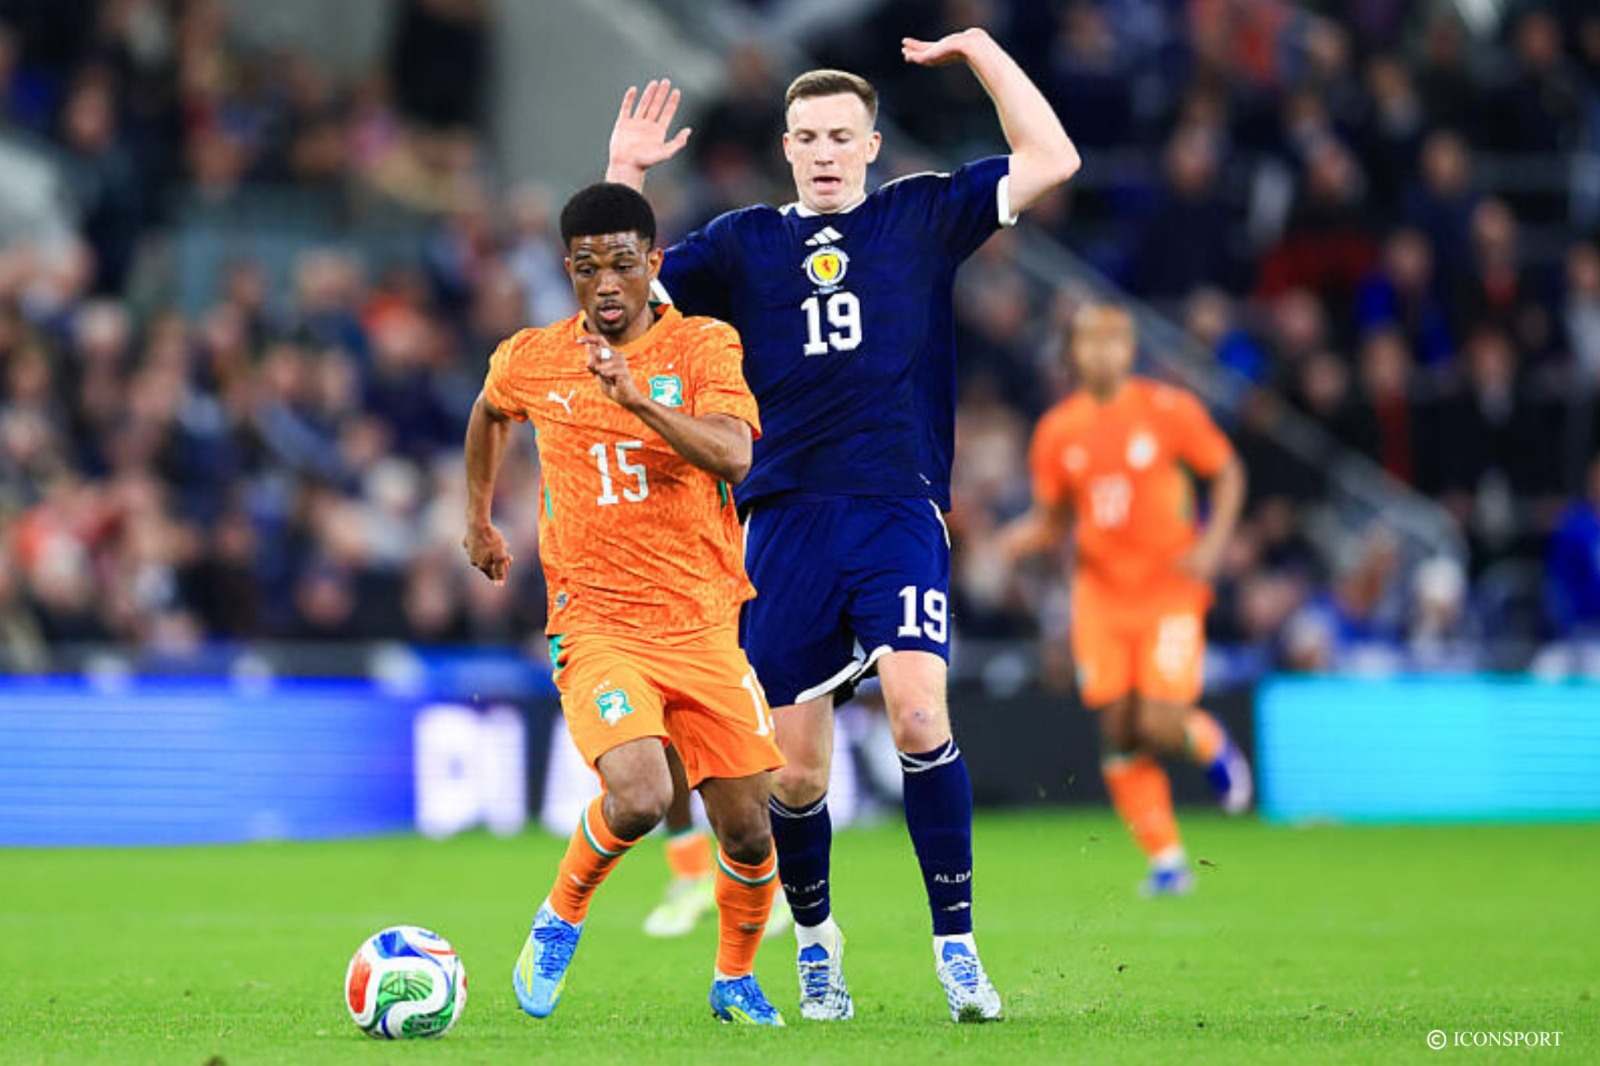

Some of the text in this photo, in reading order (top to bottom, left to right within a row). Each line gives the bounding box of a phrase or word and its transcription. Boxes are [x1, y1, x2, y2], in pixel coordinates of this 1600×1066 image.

[800, 291, 862, 357] 19
[589, 440, 650, 506] 15
[897, 585, 948, 645] 19
[740, 663, 775, 736] 1
